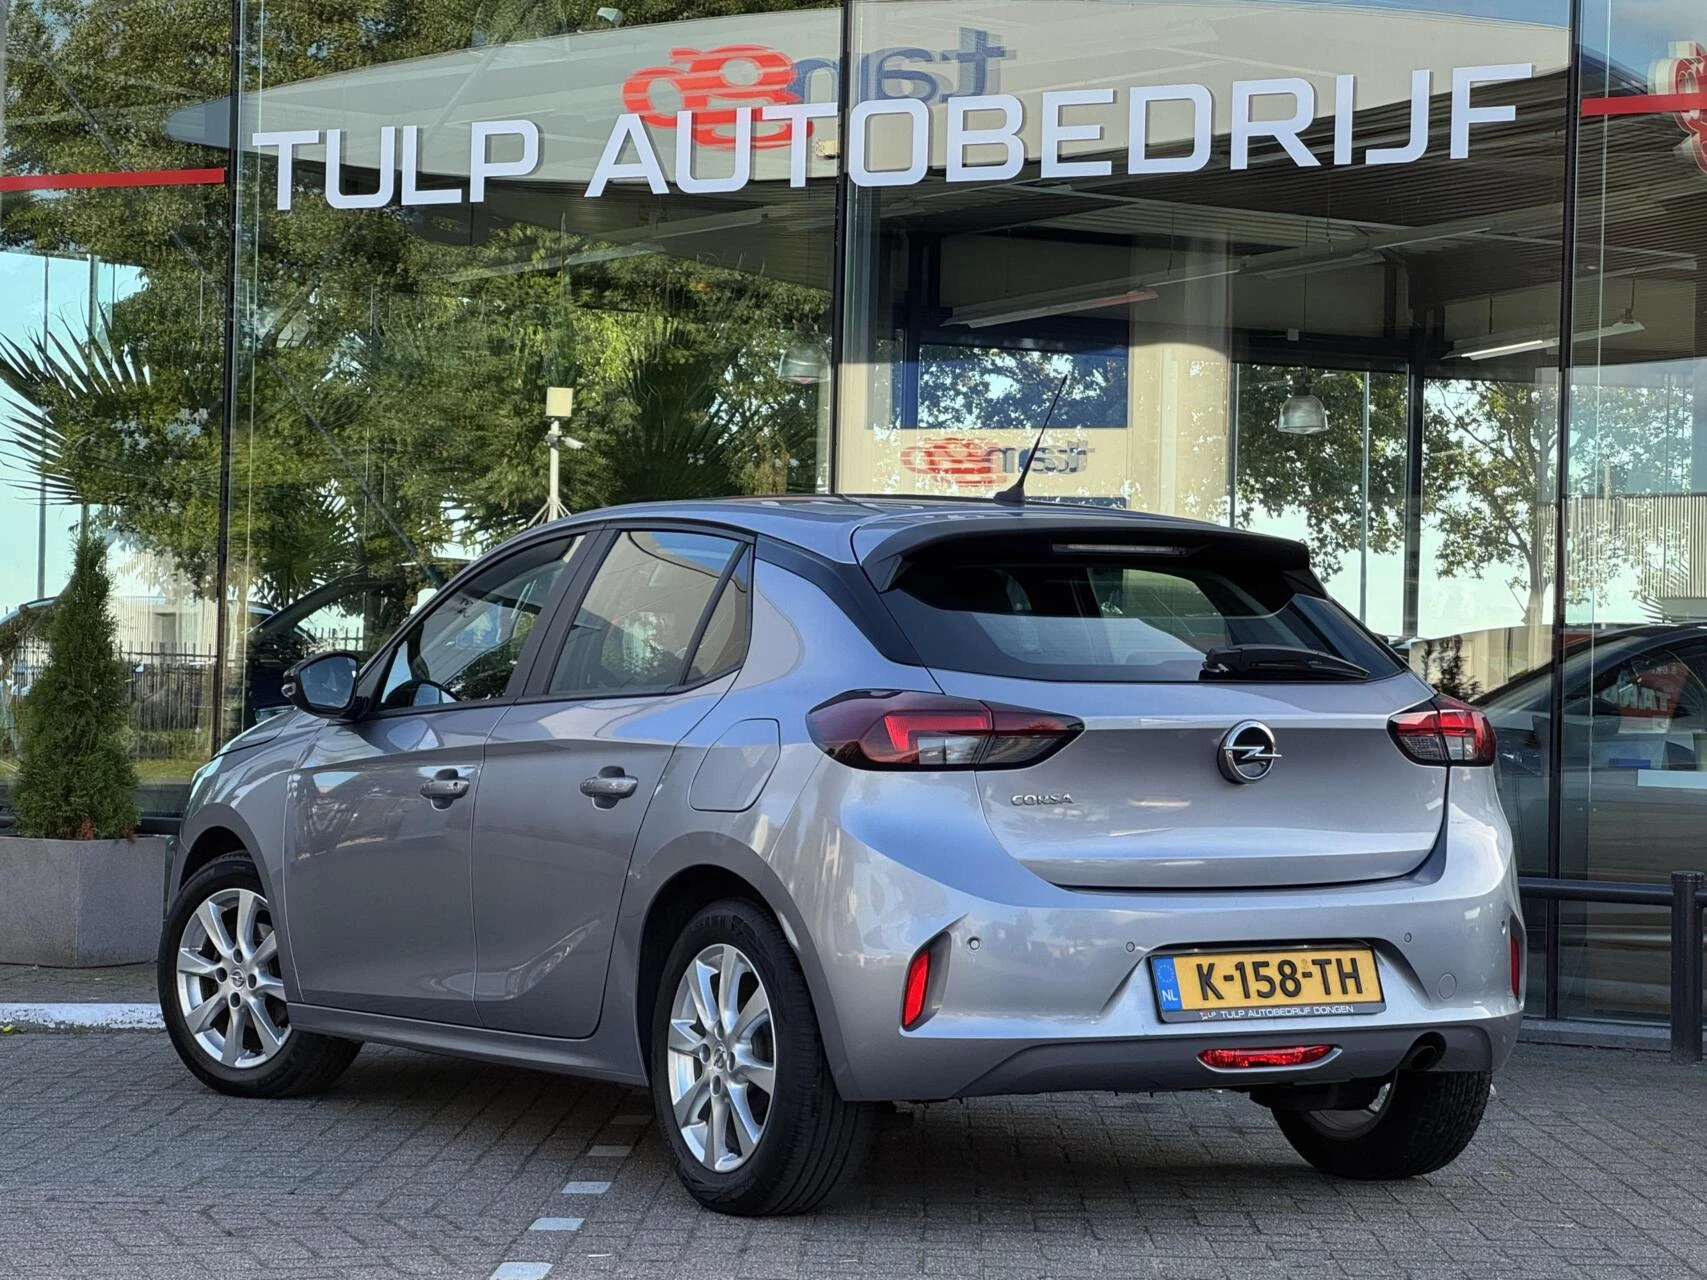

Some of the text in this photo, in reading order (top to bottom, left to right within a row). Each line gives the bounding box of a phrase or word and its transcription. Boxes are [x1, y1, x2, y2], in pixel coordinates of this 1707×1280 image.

[252, 62, 1534, 211] TULP AUTOBEDRIJF
[1011, 793, 1074, 806] CORSA
[1196, 957, 1363, 1001] K-158-TH
[1162, 990, 1178, 1001] NL
[1220, 1009, 1246, 1019] TULP
[1247, 1007, 1311, 1018] AUTOBEDRIJF
[1313, 1005, 1354, 1014] DONGEN
